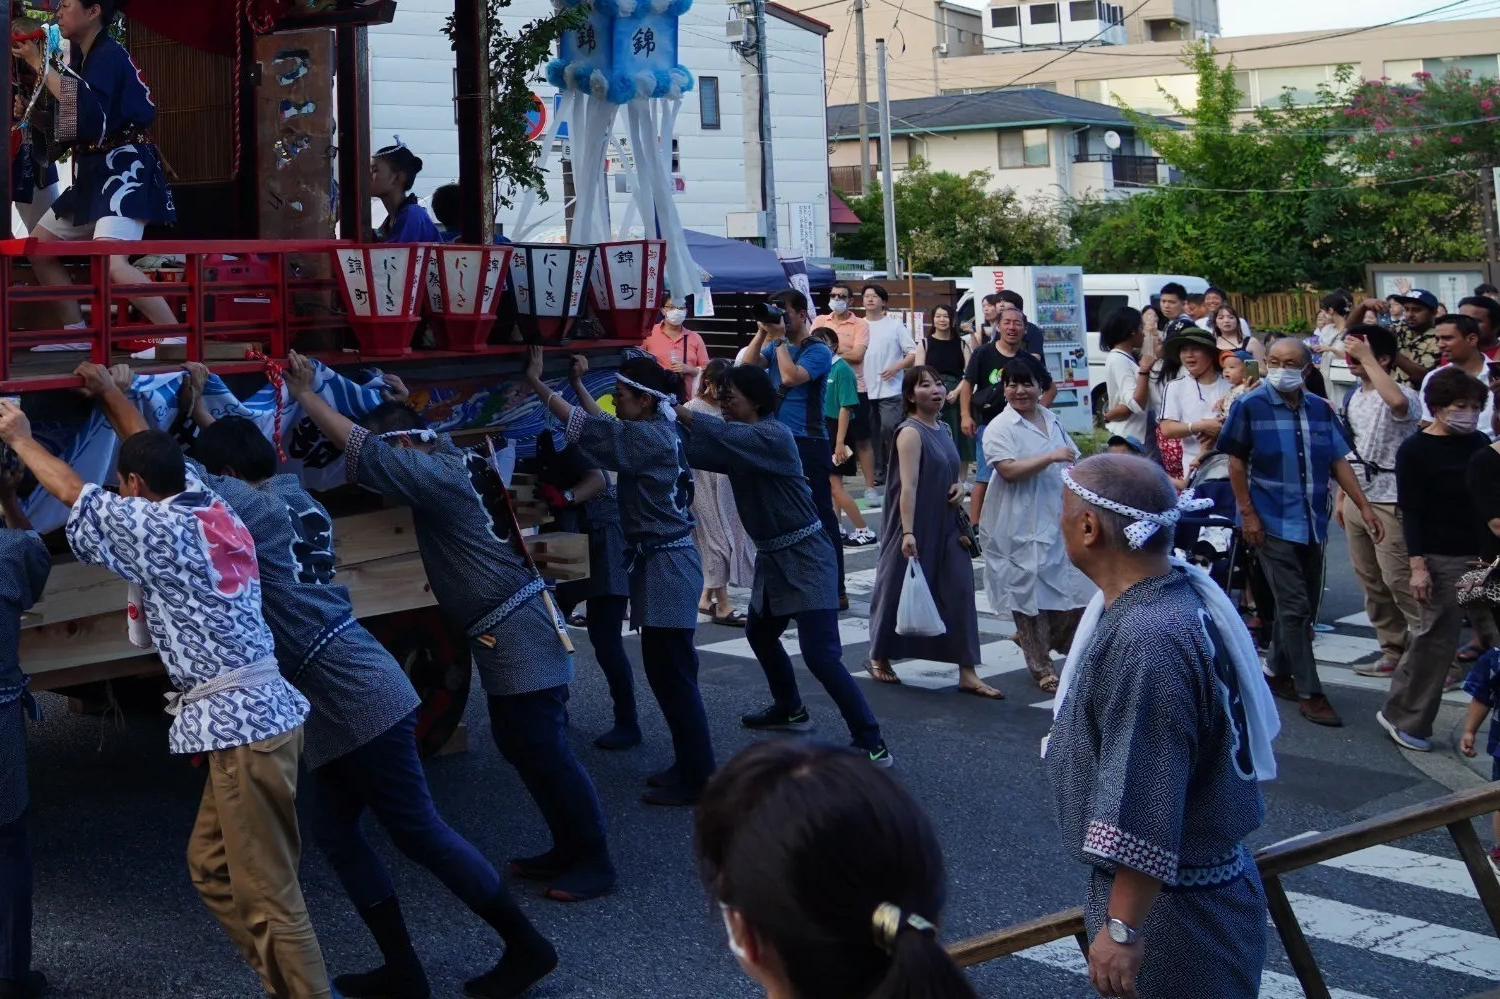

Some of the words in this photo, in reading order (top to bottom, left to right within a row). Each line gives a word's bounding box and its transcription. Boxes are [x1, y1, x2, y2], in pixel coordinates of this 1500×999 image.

[576, 22, 597, 55] 錦
[632, 27, 656, 58] 錦
[346, 255, 369, 307] 錦町
[383, 256, 398, 313] にしき
[512, 252, 530, 304] 錦町
[543, 252, 557, 309] にしき
[613, 250, 638, 301] 錦町
